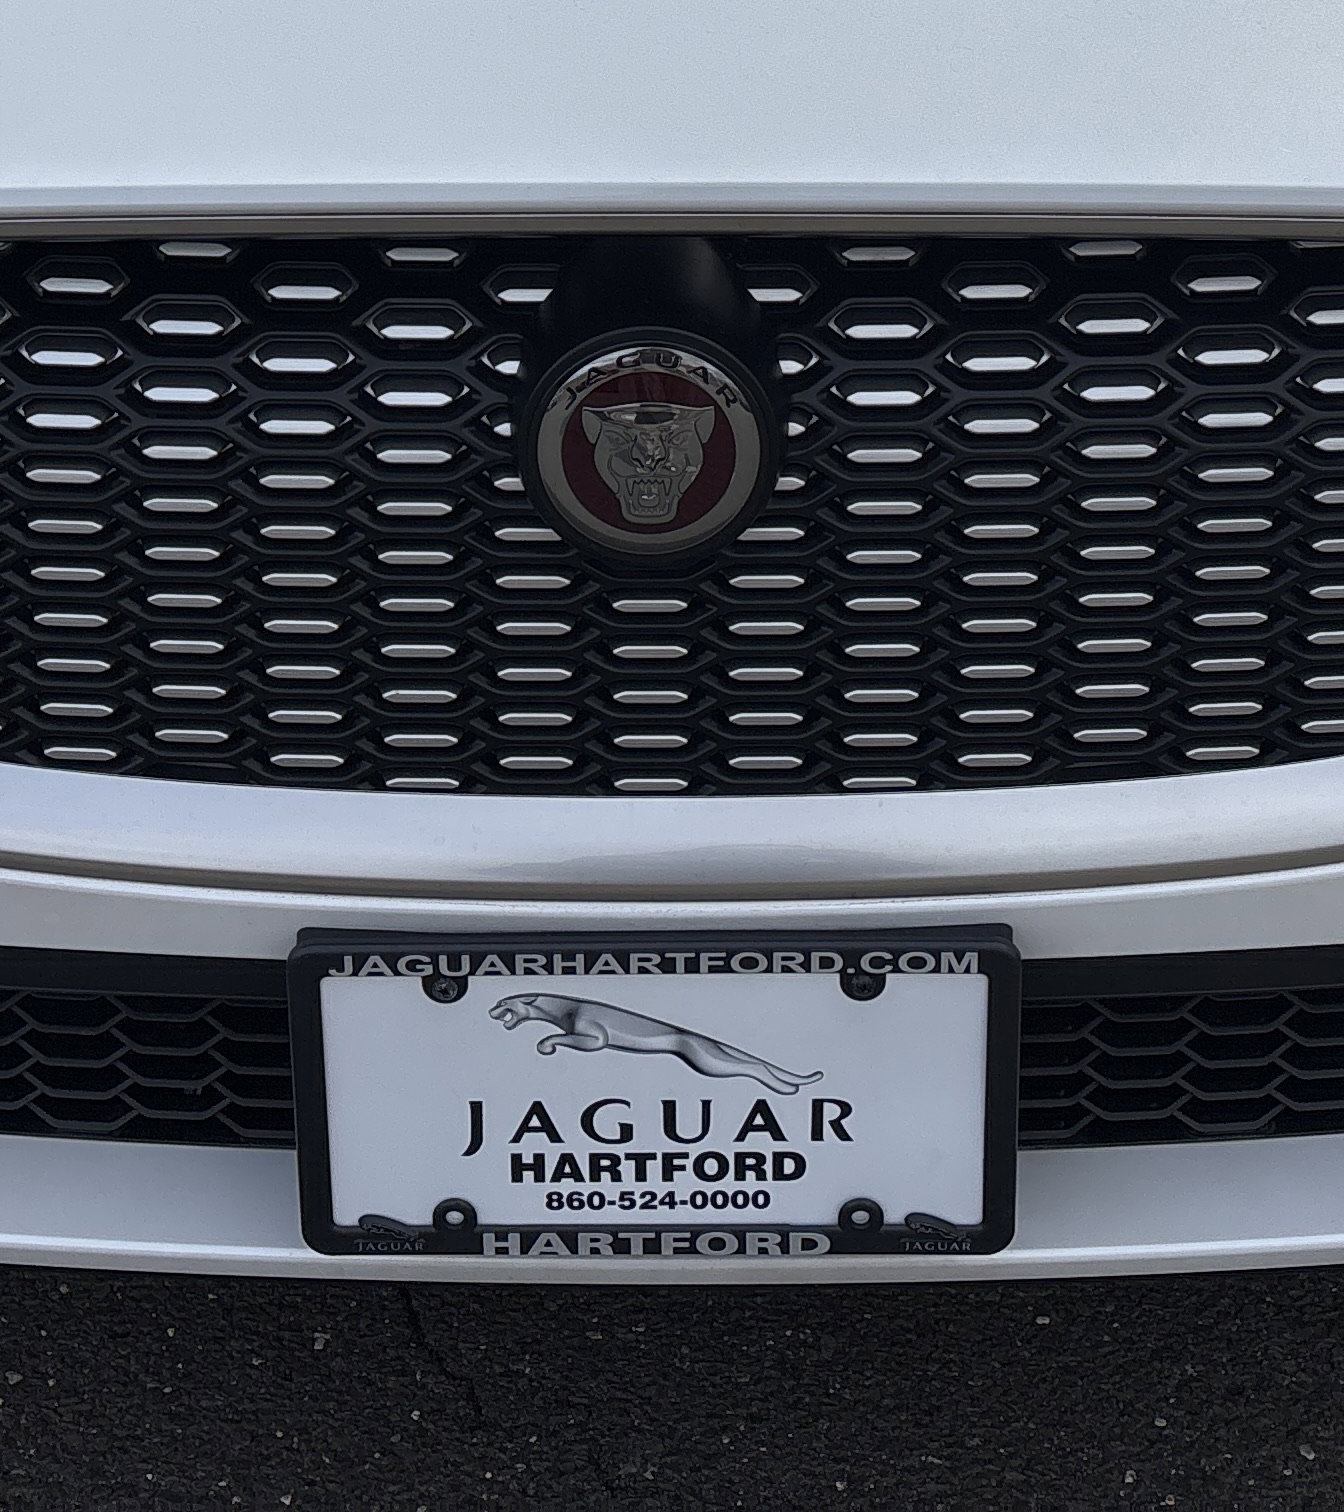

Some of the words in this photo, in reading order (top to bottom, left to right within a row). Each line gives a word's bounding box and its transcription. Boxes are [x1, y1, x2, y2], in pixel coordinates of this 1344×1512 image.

[565, 351, 740, 410] JAGUAR
[328, 951, 979, 977] JAGUARHARTFORD.COM
[460, 1098, 855, 1157] JAGUAR
[509, 1150, 807, 1184] HARTFORD
[545, 1189, 772, 1211] 860-524-0000
[357, 1240, 425, 1252] JAGUAR
[482, 1231, 832, 1257] HARTFORD
[904, 1239, 972, 1252] JAGUAR
